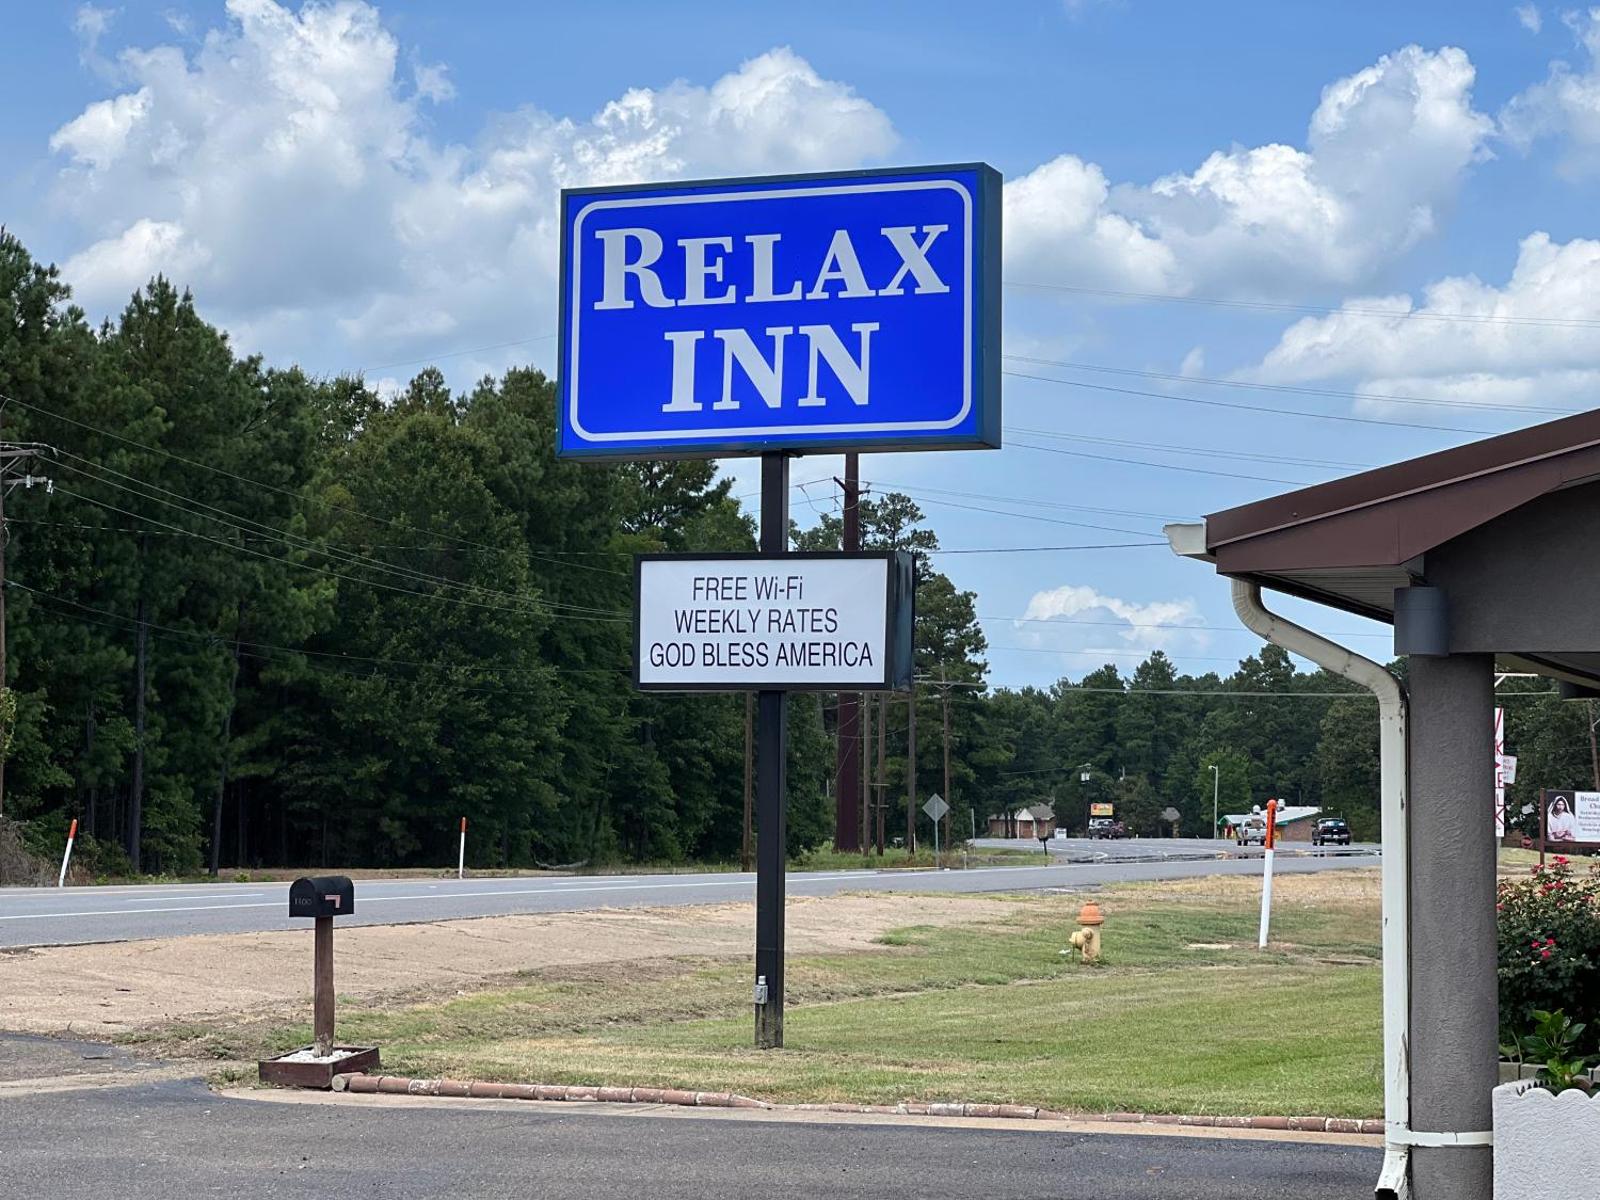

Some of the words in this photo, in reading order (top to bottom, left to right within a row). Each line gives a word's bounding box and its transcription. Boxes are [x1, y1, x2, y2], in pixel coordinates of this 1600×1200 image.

[594, 225, 950, 310] RELAX
[662, 322, 880, 412] INN
[693, 577, 748, 601] FREE
[754, 576, 803, 600] Wi-Fi
[674, 609, 761, 634] WEEKLY
[767, 608, 838, 633] RATES
[649, 643, 696, 667] GOD
[702, 642, 769, 667] BLESS
[775, 642, 873, 667] AMERICA
